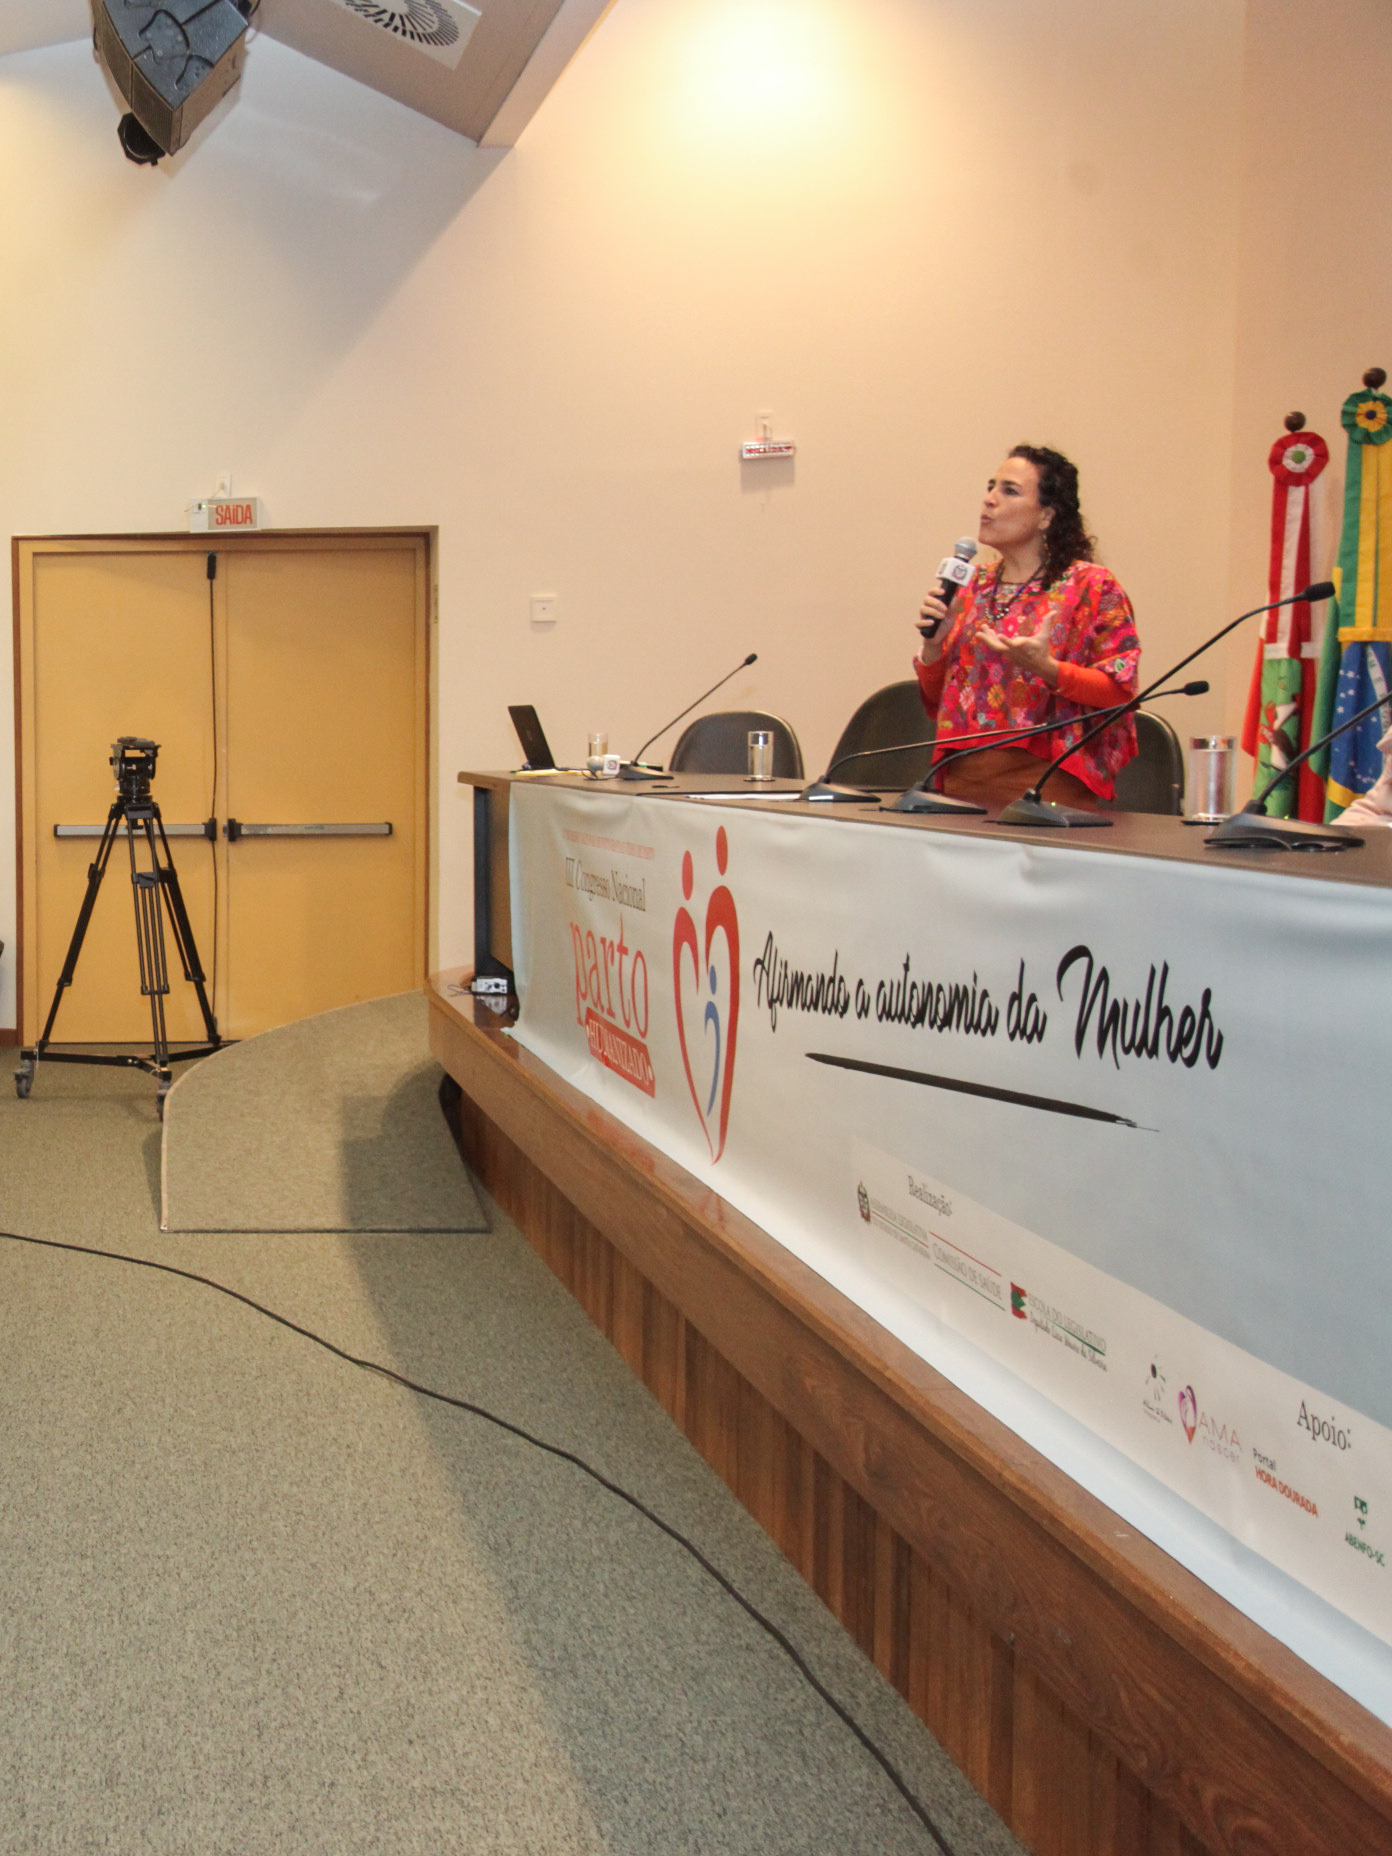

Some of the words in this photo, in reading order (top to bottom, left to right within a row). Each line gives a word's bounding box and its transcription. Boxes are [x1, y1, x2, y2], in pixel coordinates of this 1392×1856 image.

[610, 869, 646, 912] Nacional
[569, 911, 650, 1039] parto
[753, 930, 850, 1034] Afirmando
[855, 978, 870, 1020] a
[876, 951, 999, 1037] autonomia
[1007, 957, 1048, 1044] da
[1056, 945, 1224, 1070] Mulher
[1199, 1411, 1243, 1453] AMA
[1296, 1400, 1352, 1450] Apoio:
[1252, 1447, 1276, 1471] Portal
[1255, 1465, 1278, 1490] HORA
[1278, 1479, 1319, 1518] DOURADA
